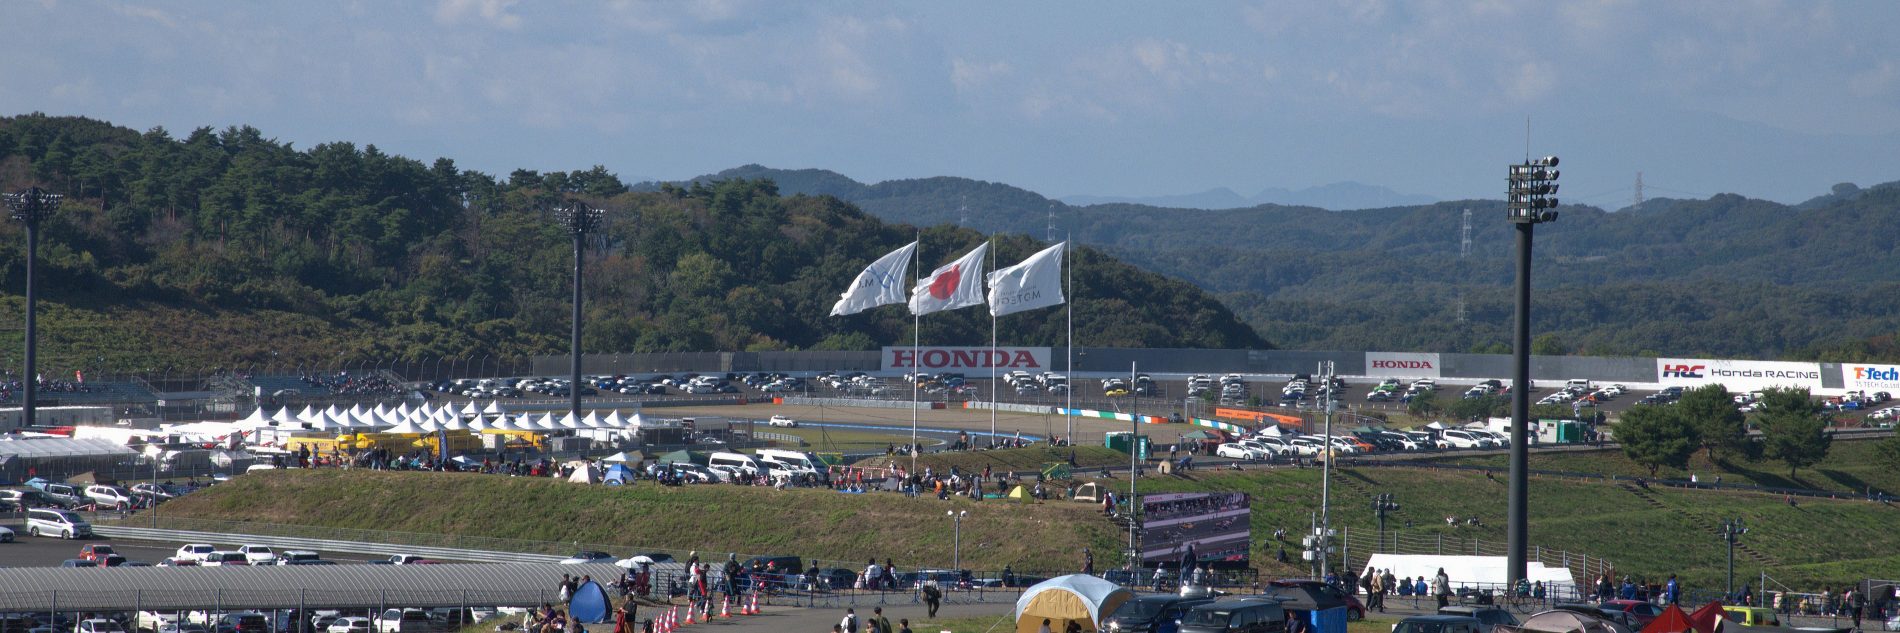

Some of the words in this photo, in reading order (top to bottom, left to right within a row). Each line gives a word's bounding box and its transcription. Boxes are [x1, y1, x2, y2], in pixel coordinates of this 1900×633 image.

[891, 349, 1041, 368] HONDA
[1372, 360, 1433, 369] HONDA
[1663, 364, 1705, 379] HRC
[1711, 368, 1763, 378] Honda
[1765, 370, 1819, 379] RACING
